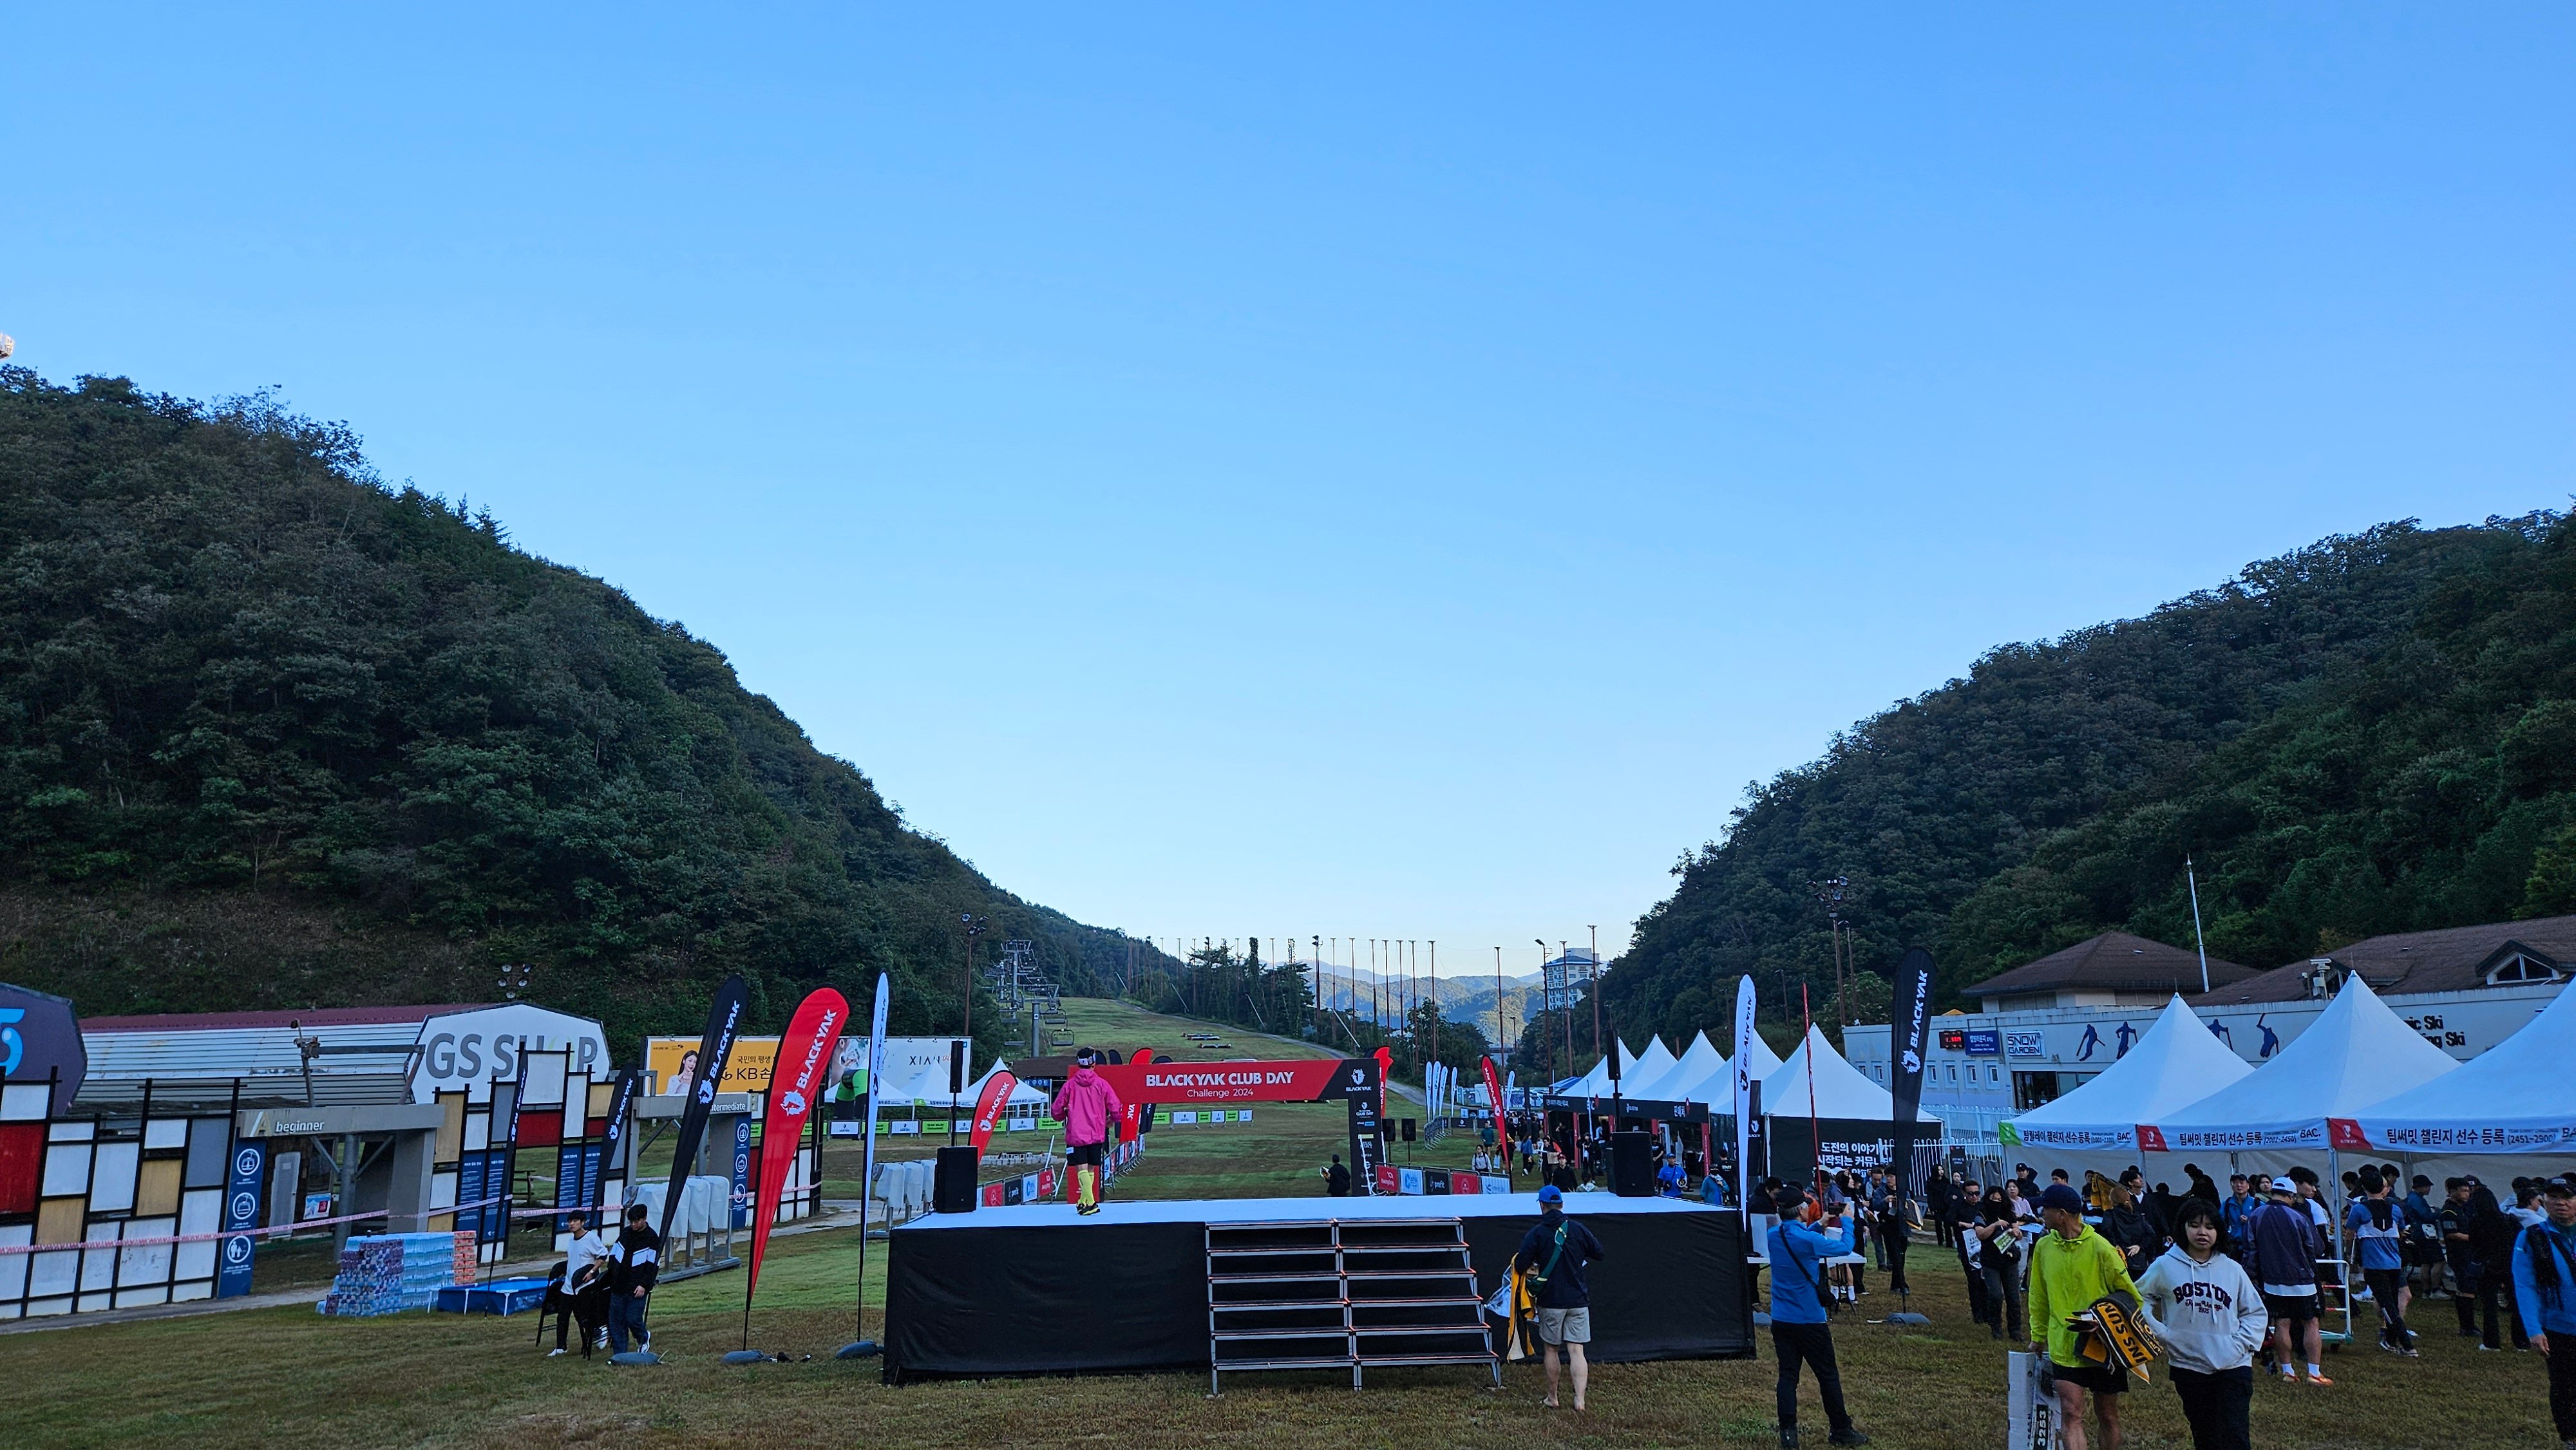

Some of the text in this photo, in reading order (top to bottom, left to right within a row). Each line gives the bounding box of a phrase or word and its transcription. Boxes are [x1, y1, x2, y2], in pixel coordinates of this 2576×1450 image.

[2423, 1015, 2443, 1030] Ski
[2008, 1036, 2037, 1046] SNOW
[2445, 1031, 2466, 1046] Ski
[426, 1033, 482, 1078] GS
[737, 1055, 770, 1064] 국민의 평생
[1228, 1072, 1262, 1085] CLUB
[1266, 1071, 1294, 1084] DAY
[1187, 1088, 1254, 1098] Challenge 2024
[710, 1102, 746, 1112] ntermediate
[275, 1120, 325, 1134] beginner
[2023, 1130, 2090, 1144] 팀릴레이 챌린지 선수 등록
[2179, 1132, 2263, 1146] 팀써밋 챌린지 선수 등록
[2387, 1128, 2505, 1145] 팀써밋 챌린지 선수 등록
[1821, 1142, 1849, 1154] 도전의
[1817, 1154, 1853, 1166] 시작되는
[2037, 1410, 2047, 1447] 3253
